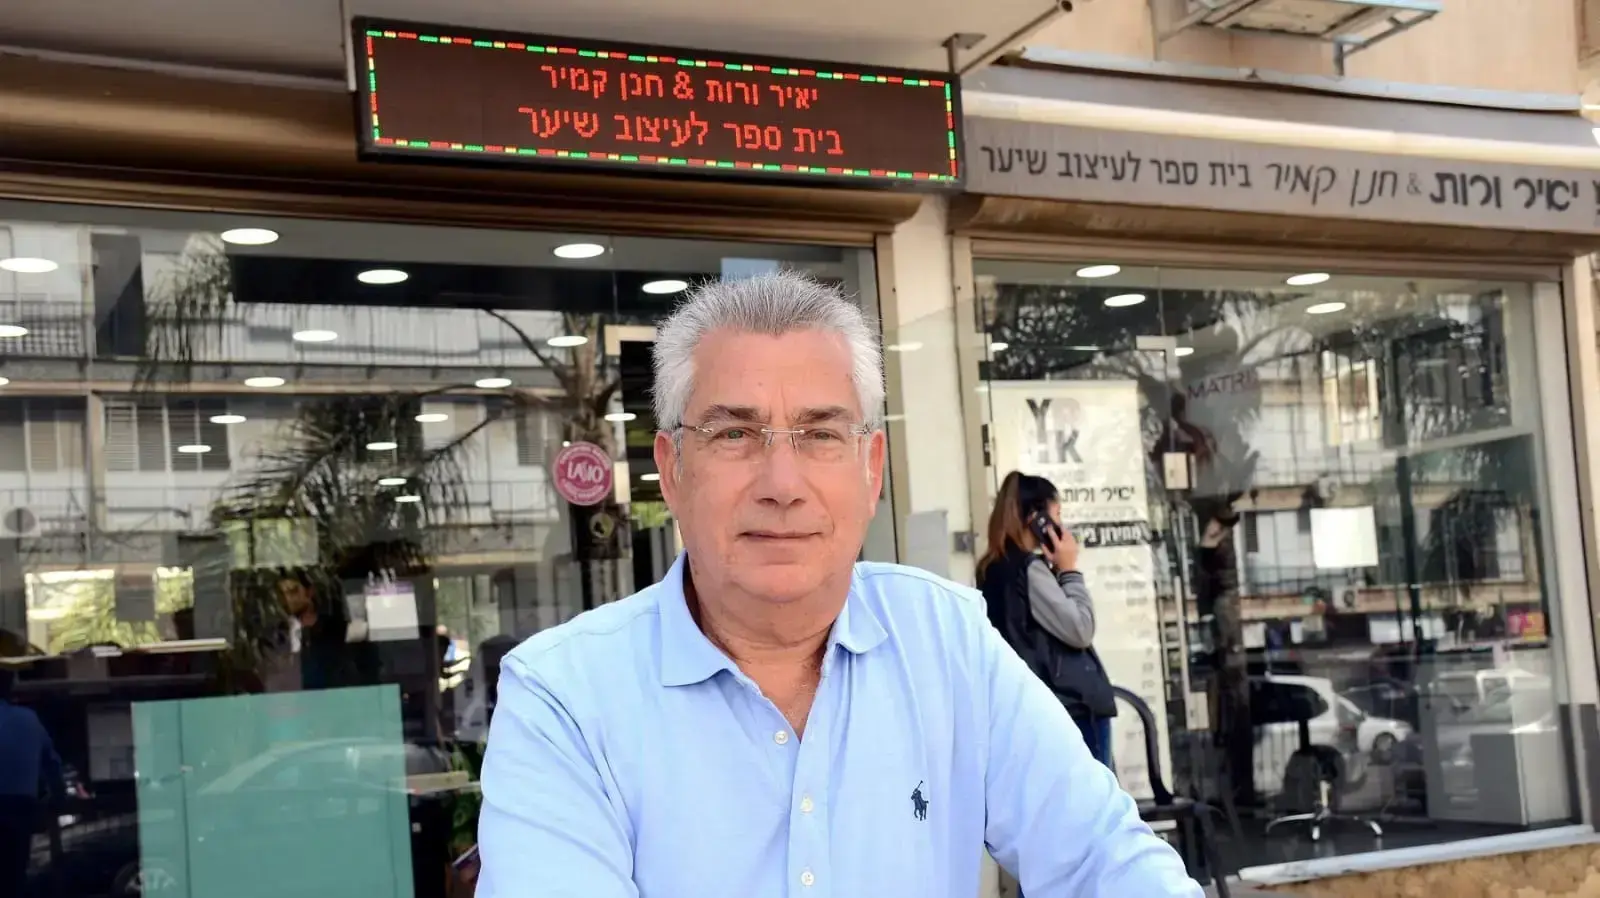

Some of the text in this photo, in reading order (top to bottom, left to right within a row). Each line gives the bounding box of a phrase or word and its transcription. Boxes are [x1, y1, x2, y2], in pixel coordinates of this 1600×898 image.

[541, 65, 819, 109] יאיר ורות & חנן קמיר
[518, 107, 843, 154] בית ספר לעיצוב שיער
[980, 145, 1047, 175] שיער
[1056, 150, 1142, 182] לעיצוב
[1149, 157, 1198, 186] ספר
[1208, 161, 1252, 188] בית
[1265, 162, 1336, 206] קמיר
[1349, 168, 1399, 207] חנן
[1406, 172, 1422, 196] &
[1429, 172, 1502, 209] ורות
[1513, 177, 1579, 212] יאיר
